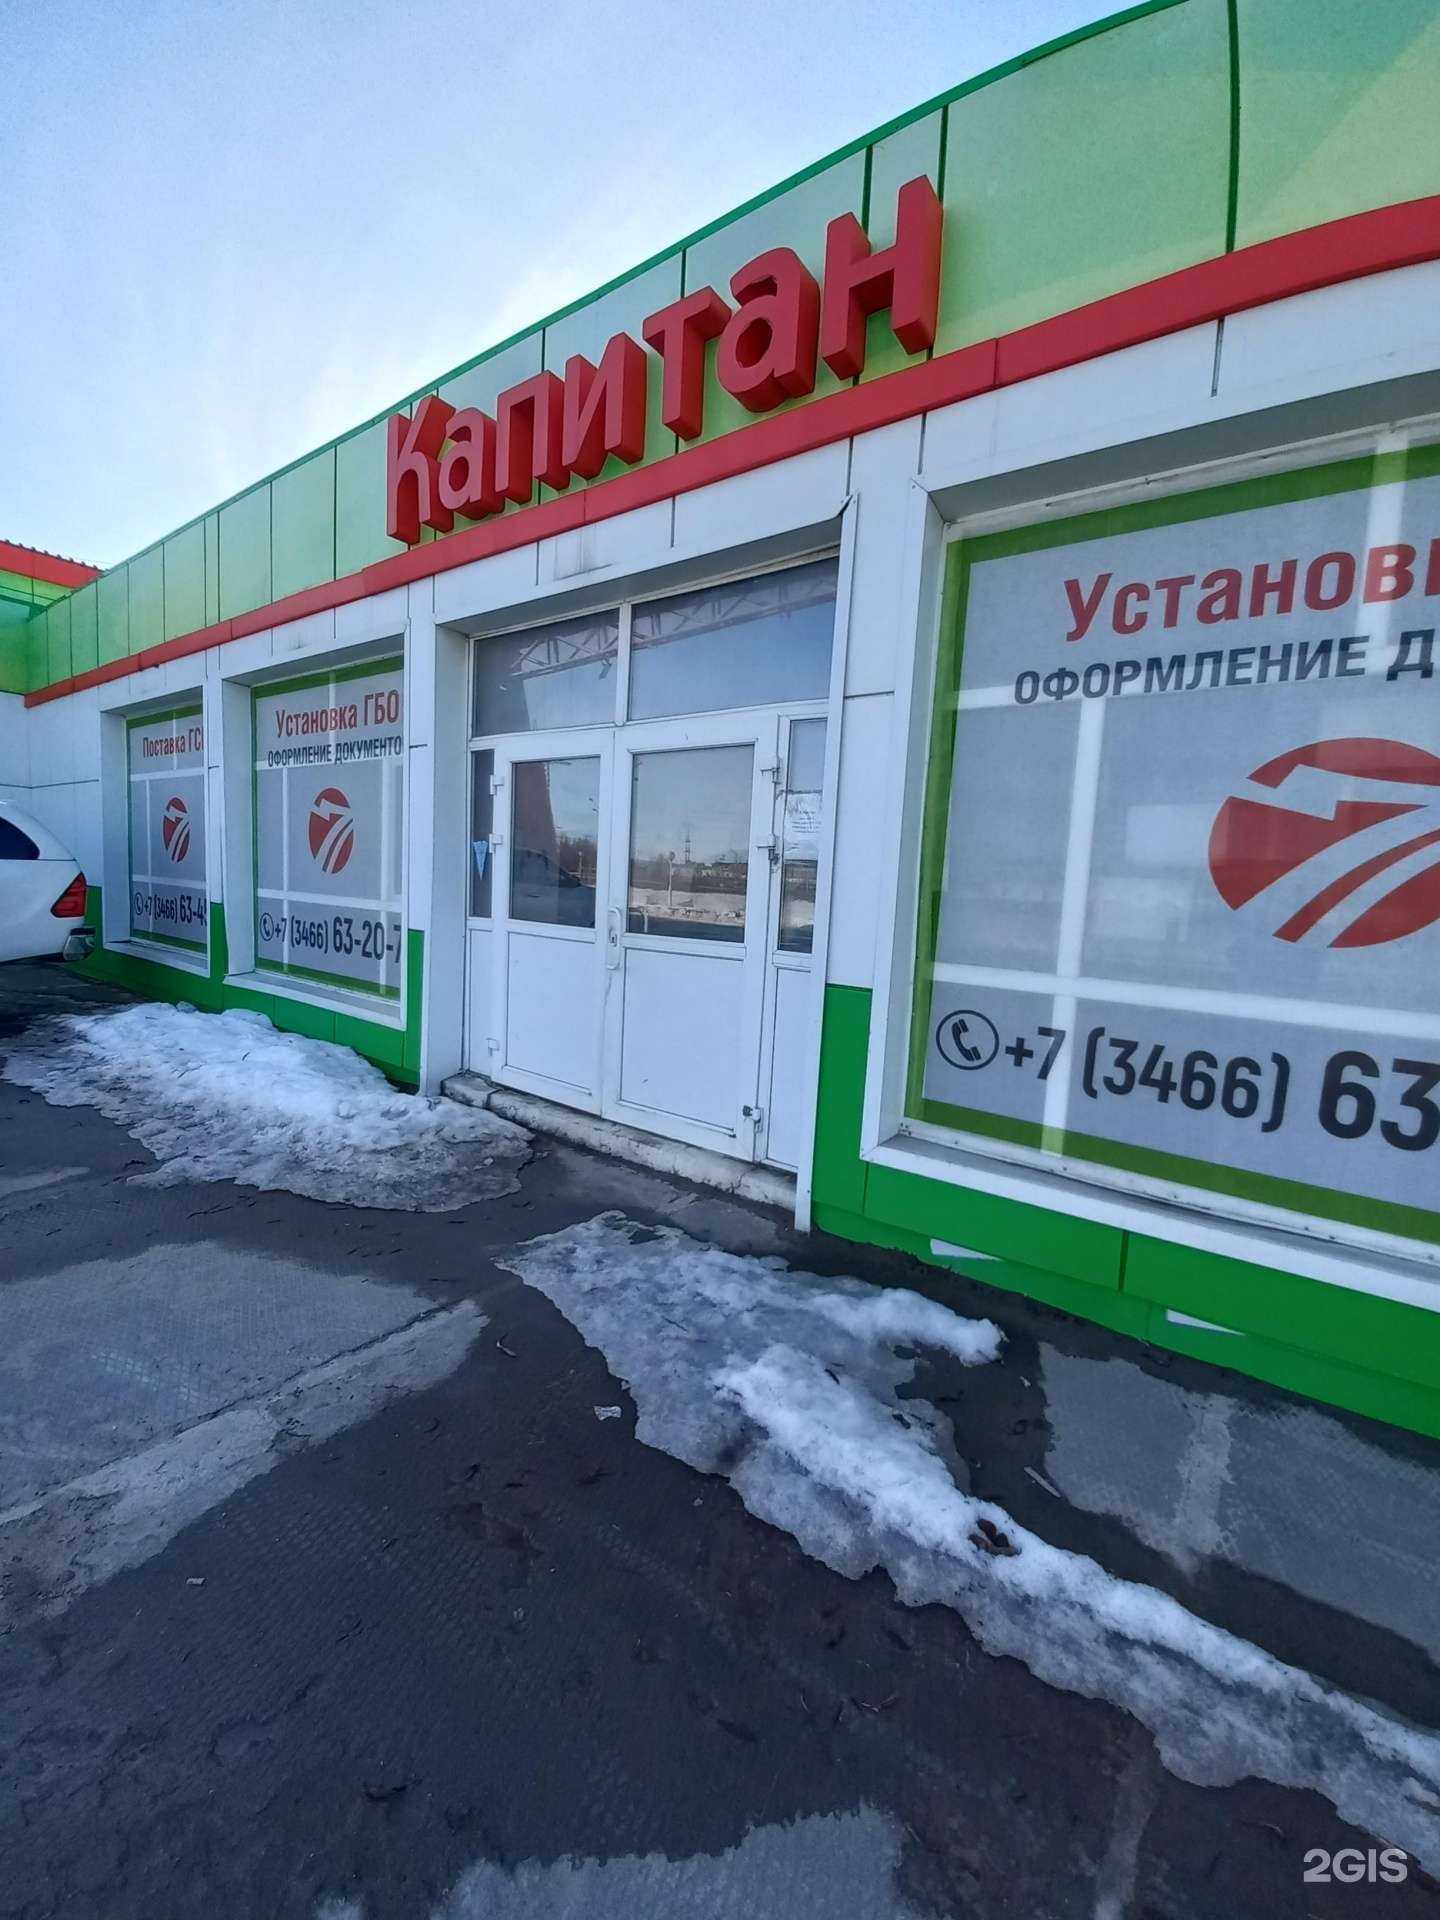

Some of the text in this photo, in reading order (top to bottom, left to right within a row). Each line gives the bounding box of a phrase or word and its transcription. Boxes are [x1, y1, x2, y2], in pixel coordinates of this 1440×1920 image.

[387, 174, 944, 544] Капитан
[1014, 634, 1370, 705] ОФОРМЛЕНИЕ
[275, 689, 400, 738] Установка ГБО
[143, 735, 186, 758] Поставка
[267, 743, 332, 768] ОФОРМЛЕНИЕ
[144, 896, 153, 916] +7
[153, 894, 178, 924] (3466)
[274, 918, 288, 948] +7
[290, 916, 329, 954] (3466)
[1004, 1027, 1440, 1151] +7 (3466) 63
